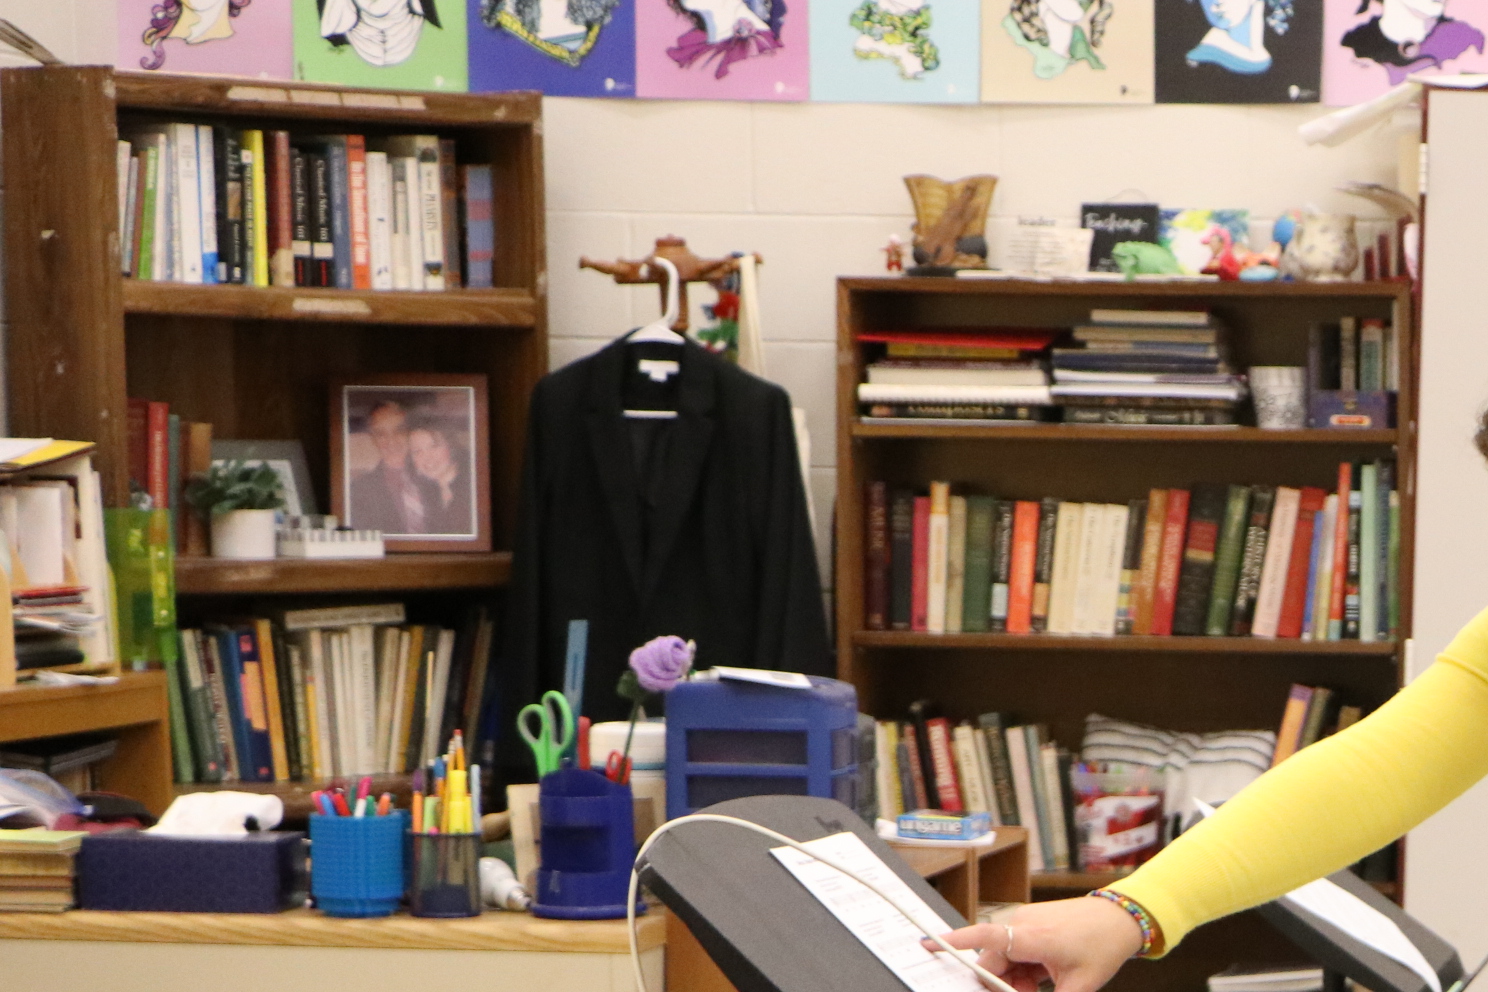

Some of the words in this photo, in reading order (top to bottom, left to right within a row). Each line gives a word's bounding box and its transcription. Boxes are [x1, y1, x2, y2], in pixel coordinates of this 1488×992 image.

[295, 157, 304, 194] Classical
[317, 159, 327, 196] Classical
[296, 196, 305, 222] Music
[319, 198, 328, 224] Music
[899, 819, 962, 834] ungame
